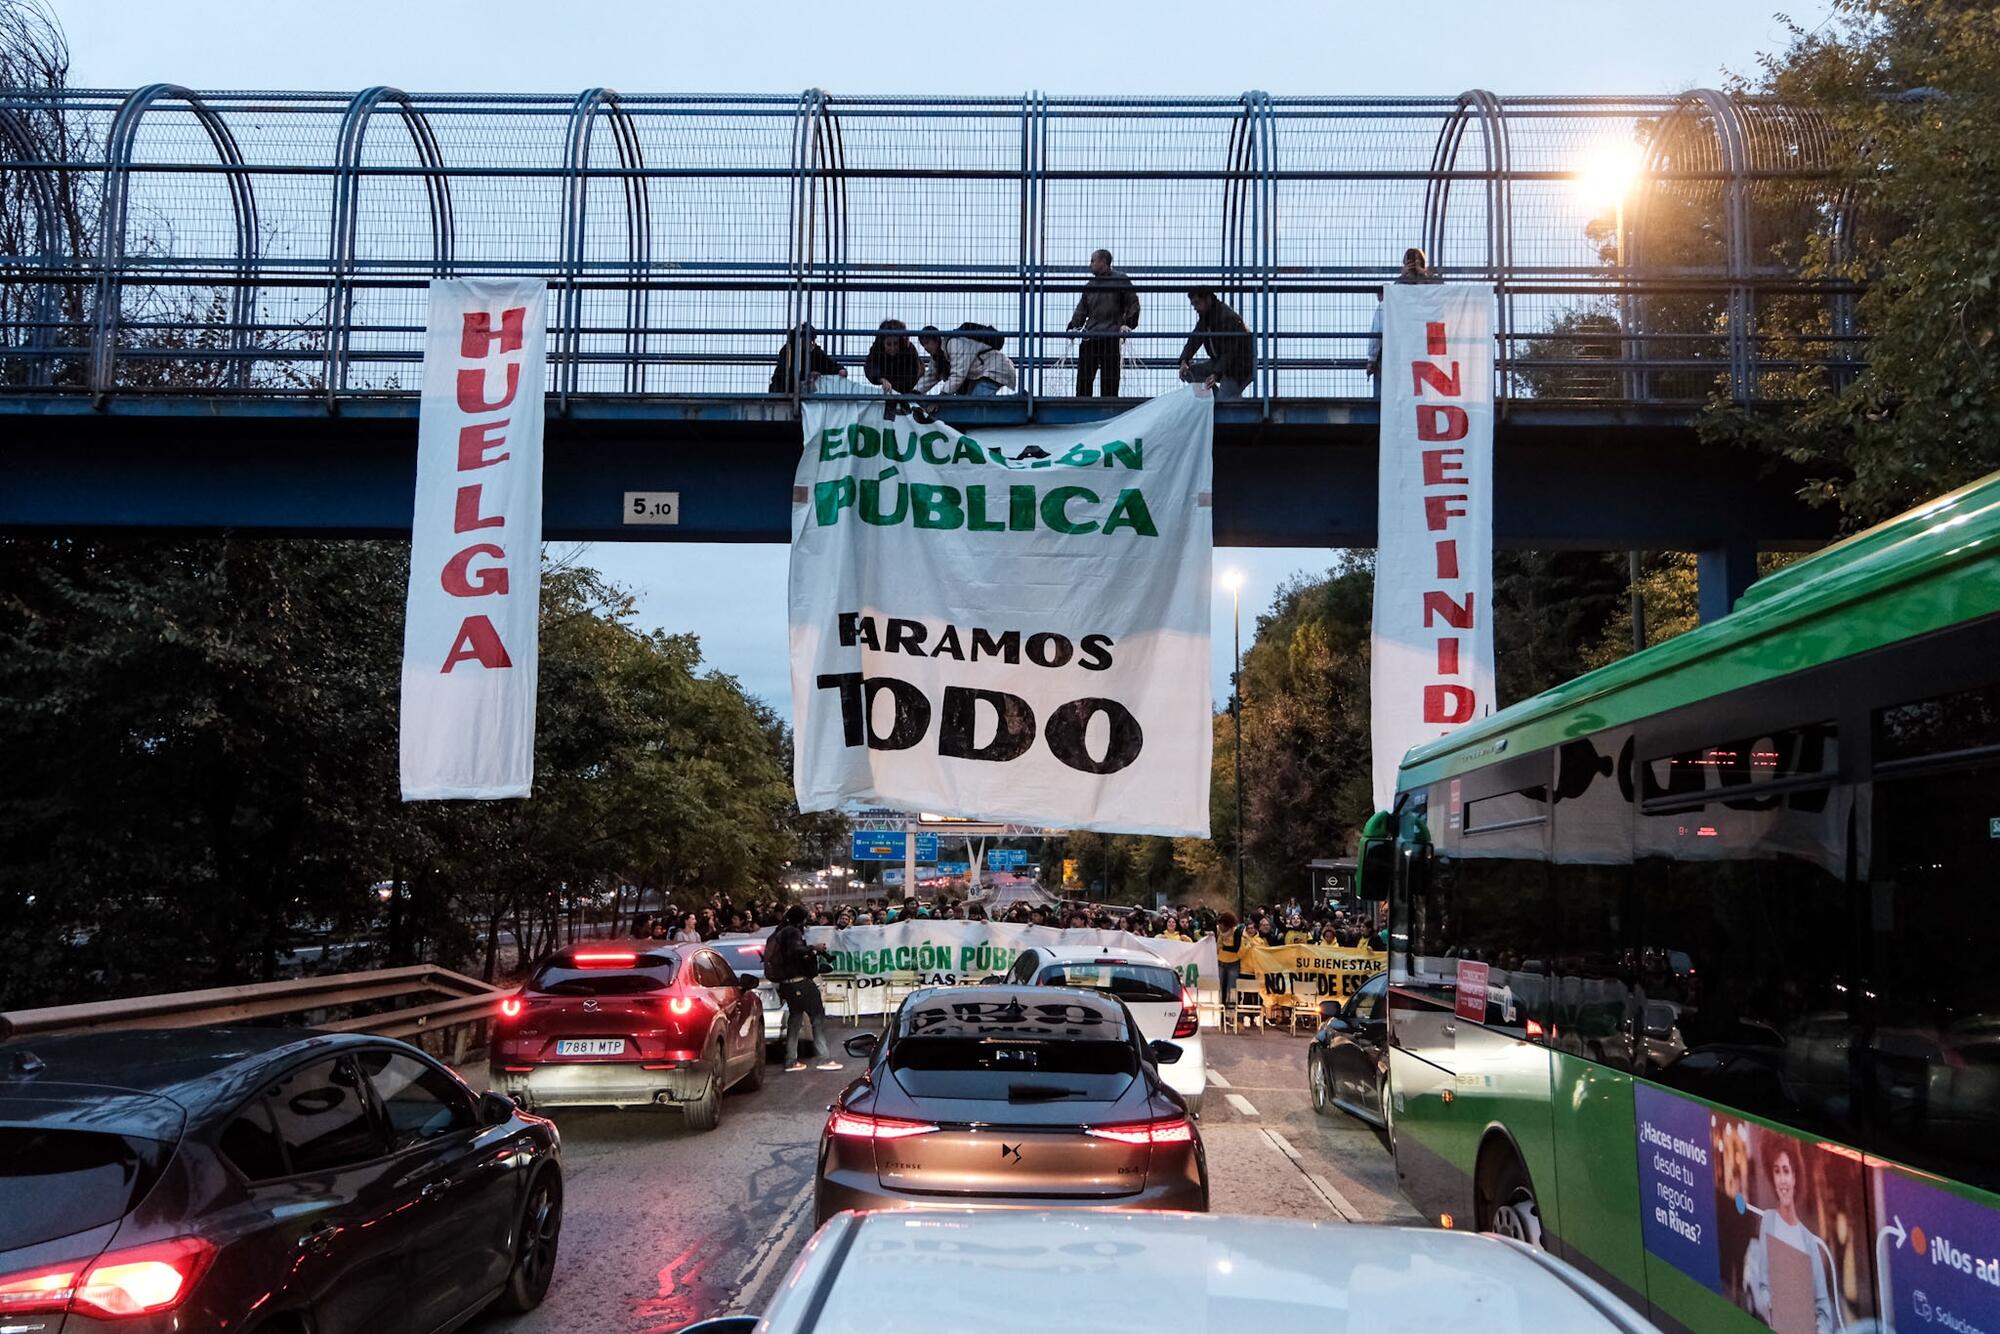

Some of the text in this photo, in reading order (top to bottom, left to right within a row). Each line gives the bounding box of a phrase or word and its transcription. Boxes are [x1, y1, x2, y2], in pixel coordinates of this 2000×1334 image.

[440, 307, 527, 673] HUELGA
[633, 497, 671, 519] 5,10
[814, 465, 1159, 537] PÚBLICA
[1411, 322, 1476, 736] INDEFINID
[817, 672, 1143, 775] TODO
[1296, 957, 1382, 971] SU BIENESTAR
[1264, 972, 1286, 995] NO
[565, 1041, 622, 1053] 7881 MTP
[1640, 1120, 1672, 1150] ¿Haces
[1653, 1151, 1694, 1187] desde tu
[1657, 1182, 1694, 1214] negocio
[1655, 1207, 1702, 1244] en Rivas?
[1931, 1236, 1972, 1275] ¡Nos
